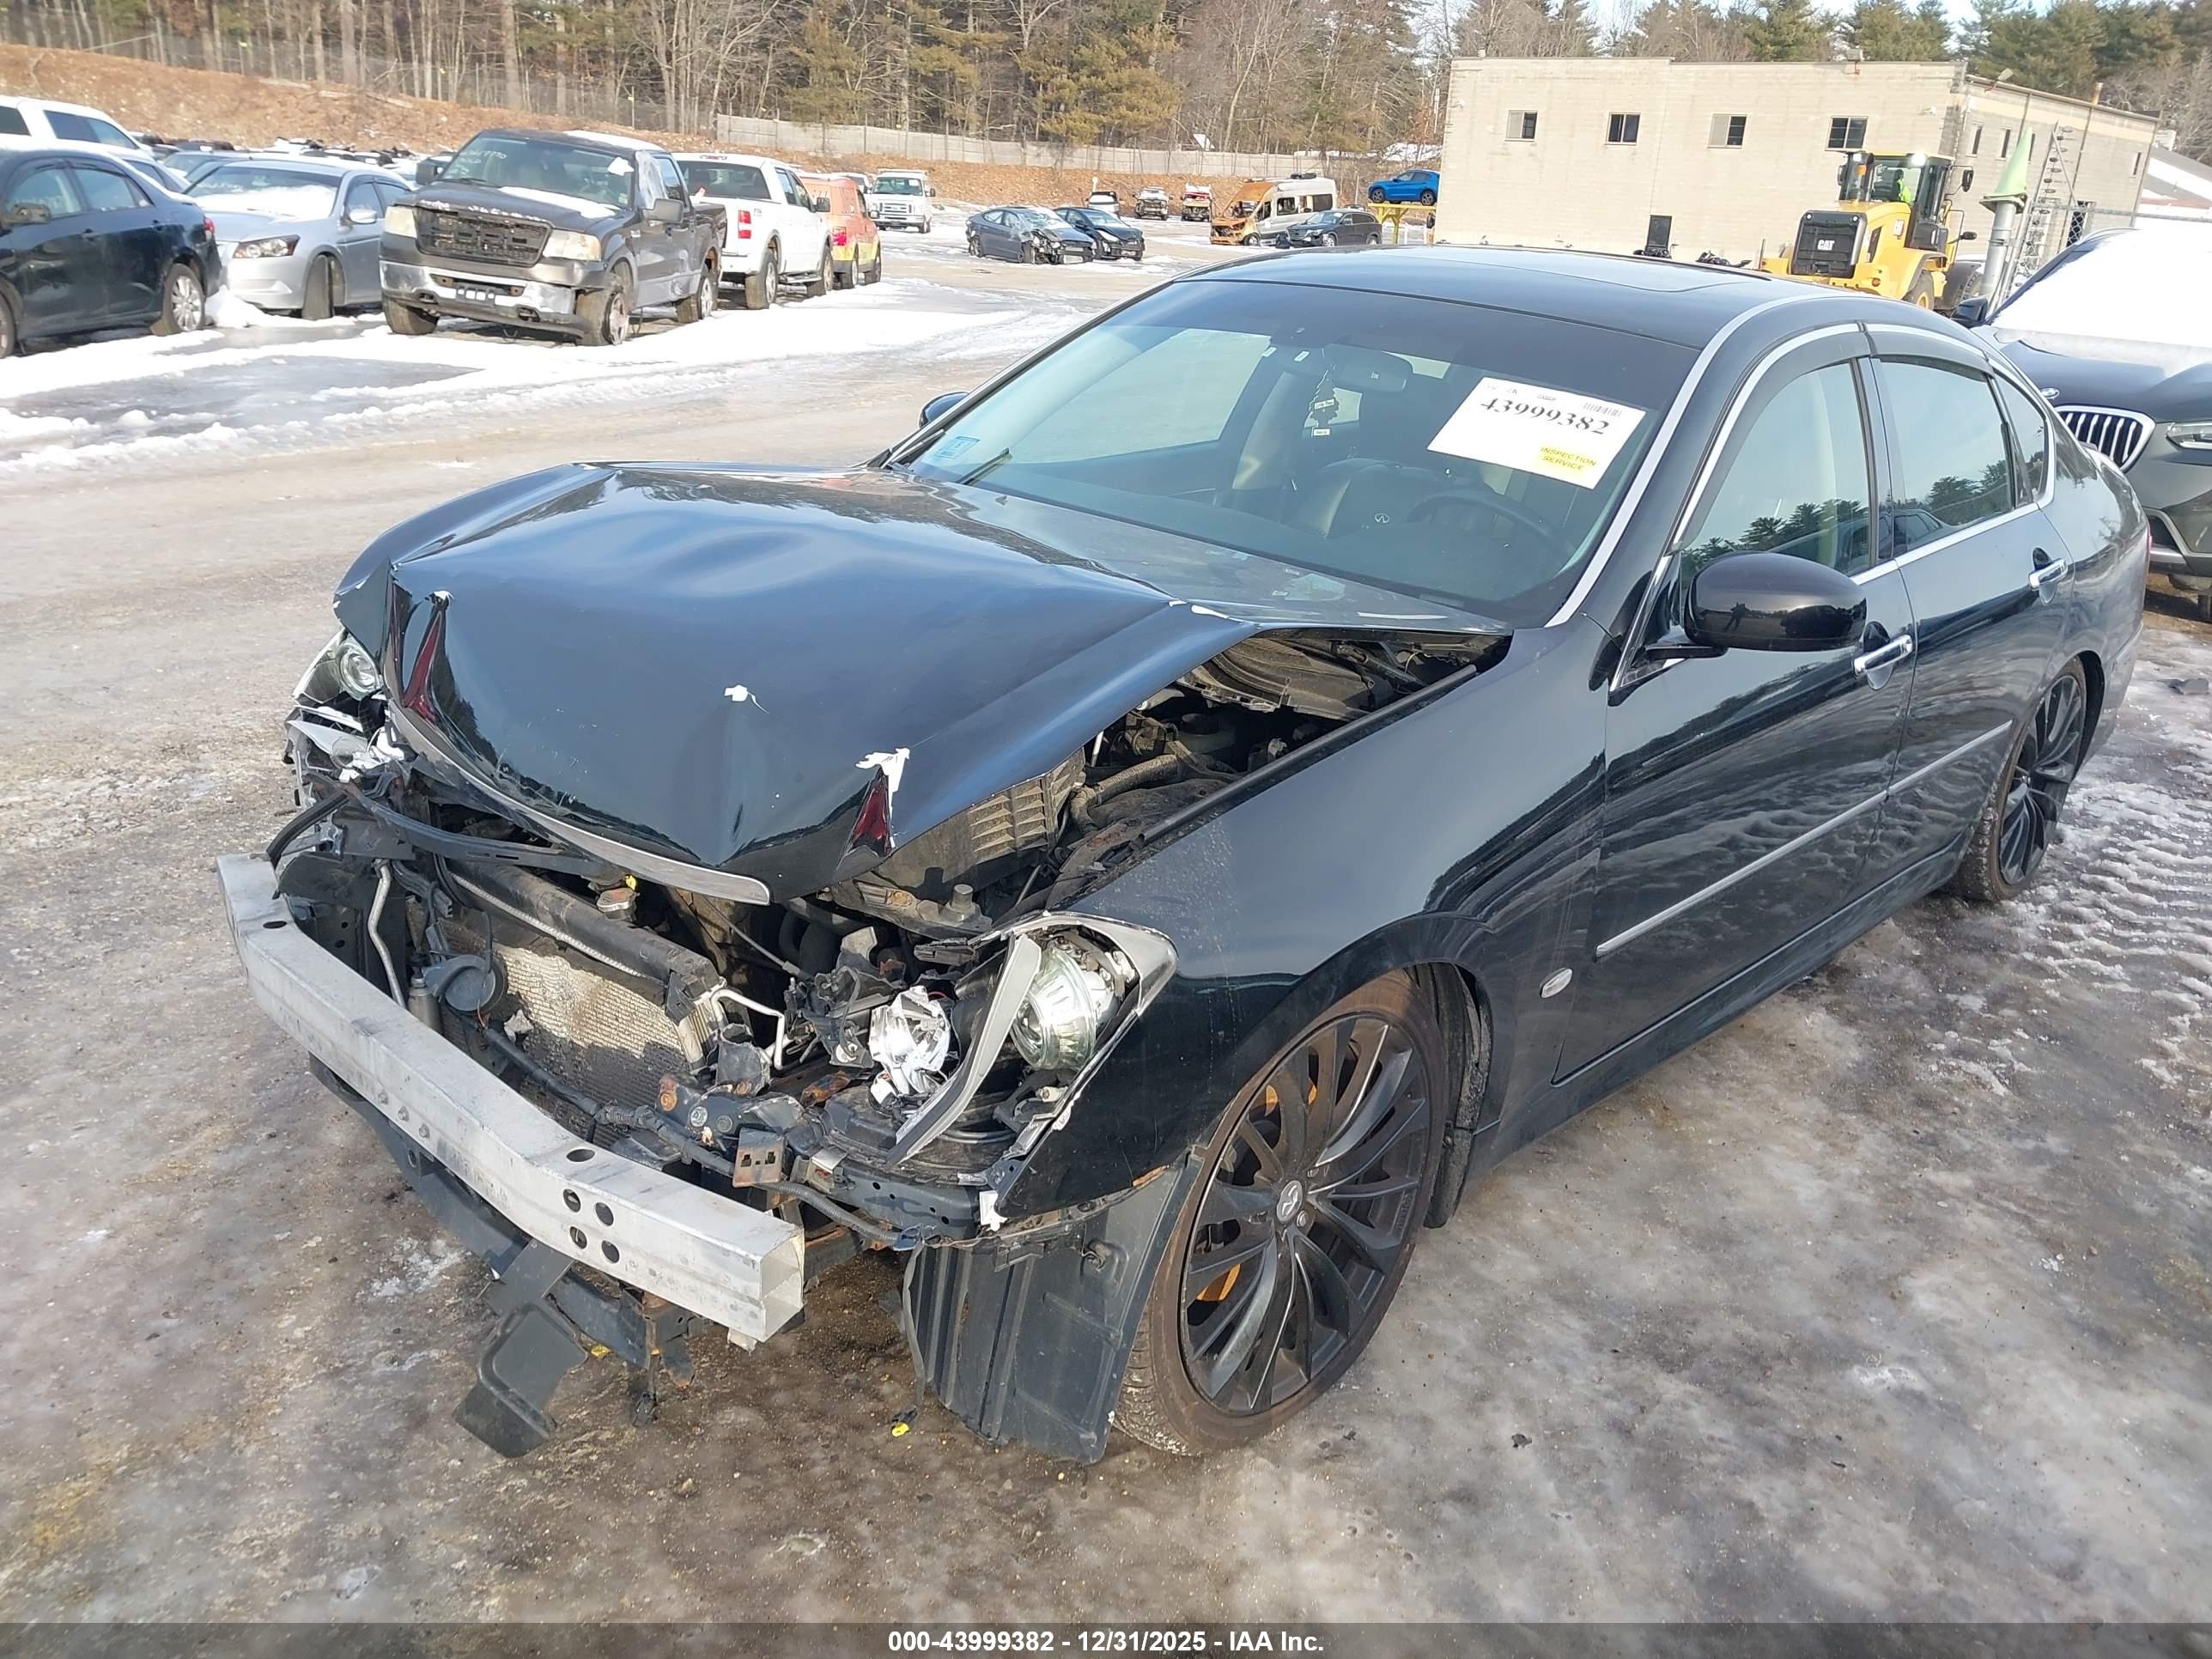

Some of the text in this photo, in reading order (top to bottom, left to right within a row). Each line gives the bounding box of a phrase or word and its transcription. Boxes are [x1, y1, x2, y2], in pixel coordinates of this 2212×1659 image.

[1817, 239, 1835, 251] CAT
[1480, 398, 1610, 435] 43999382
[1540, 447, 1597, 466] INSPECTION
[1542, 455, 1585, 470] SERVICE
